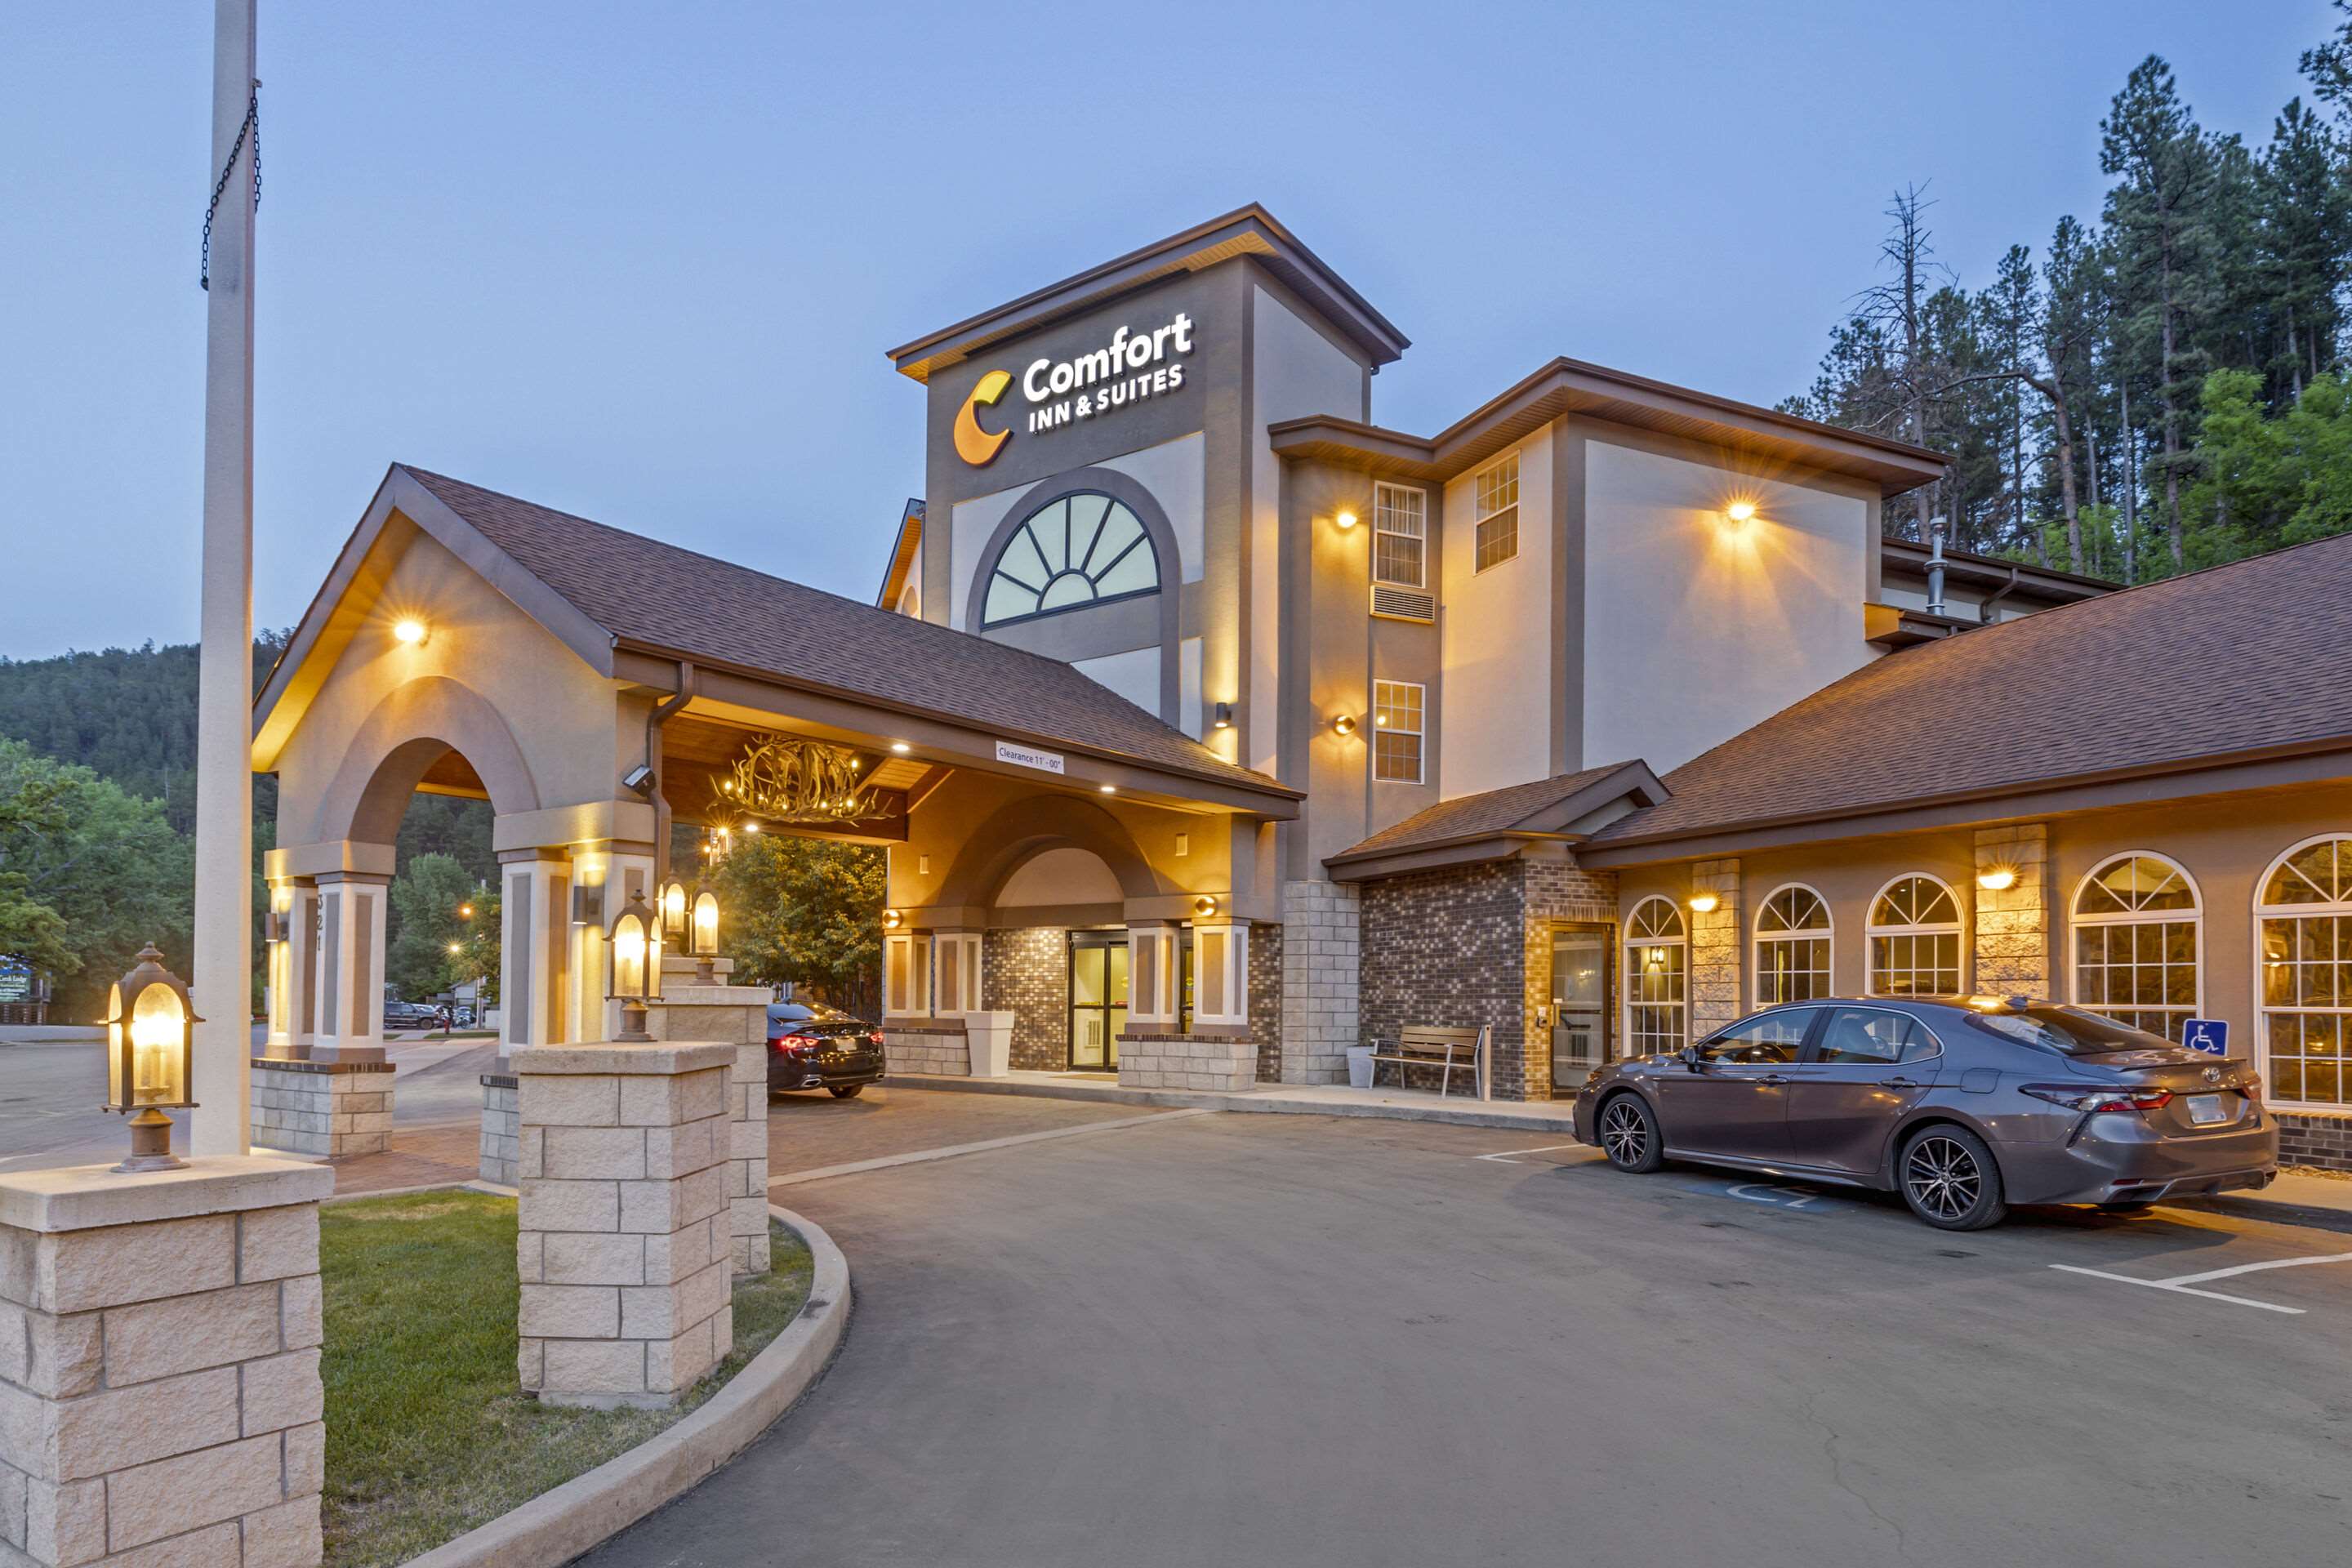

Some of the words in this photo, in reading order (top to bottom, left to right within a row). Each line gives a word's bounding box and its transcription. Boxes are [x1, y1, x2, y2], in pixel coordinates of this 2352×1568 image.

[1022, 313, 1192, 403] Comfort
[1028, 401, 1071, 433] INN
[1075, 394, 1093, 417] &
[1095, 363, 1183, 411] SUITES
[999, 747, 1034, 763] Clearance
